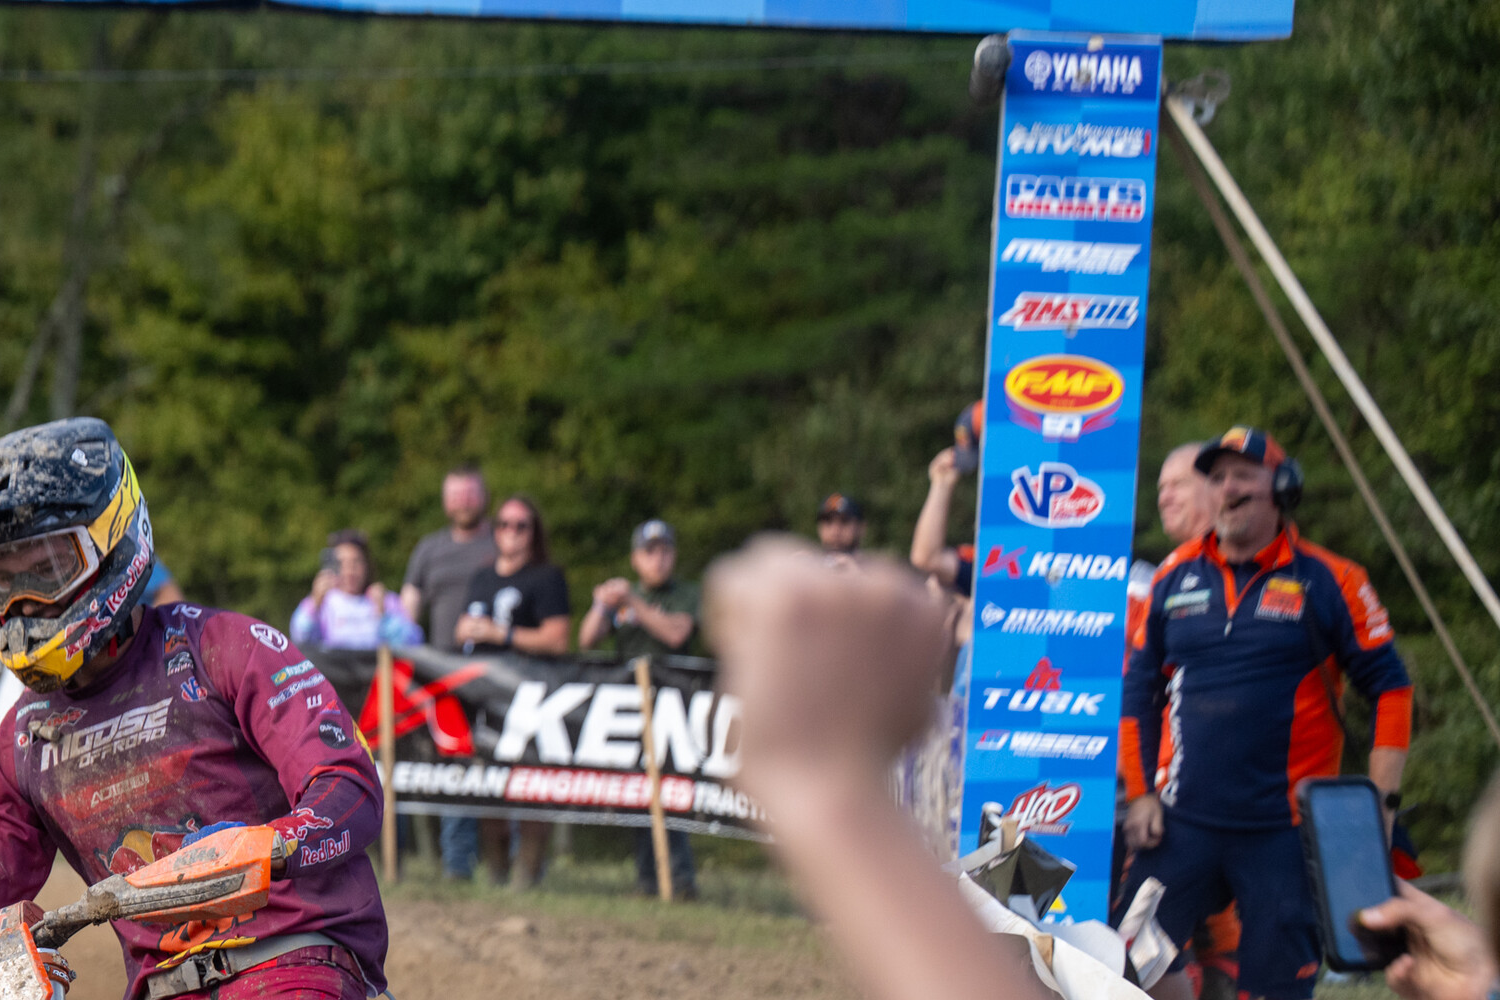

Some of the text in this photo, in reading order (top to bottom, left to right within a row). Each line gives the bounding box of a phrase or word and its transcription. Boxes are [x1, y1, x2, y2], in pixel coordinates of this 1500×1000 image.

[1052, 52, 1142, 86] YAMAHA
[1012, 369, 1112, 397] FMF
[1016, 468, 1076, 519] VP
[105, 533, 150, 615] Red Bull
[1027, 551, 1127, 581] KENDA
[41, 696, 174, 772] MOOSE
[79, 726, 167, 769] OFFROAD
[1010, 731, 1109, 754] WISECO
[507, 767, 695, 812] ENGINEEED
[300, 829, 351, 868] Red Bull
